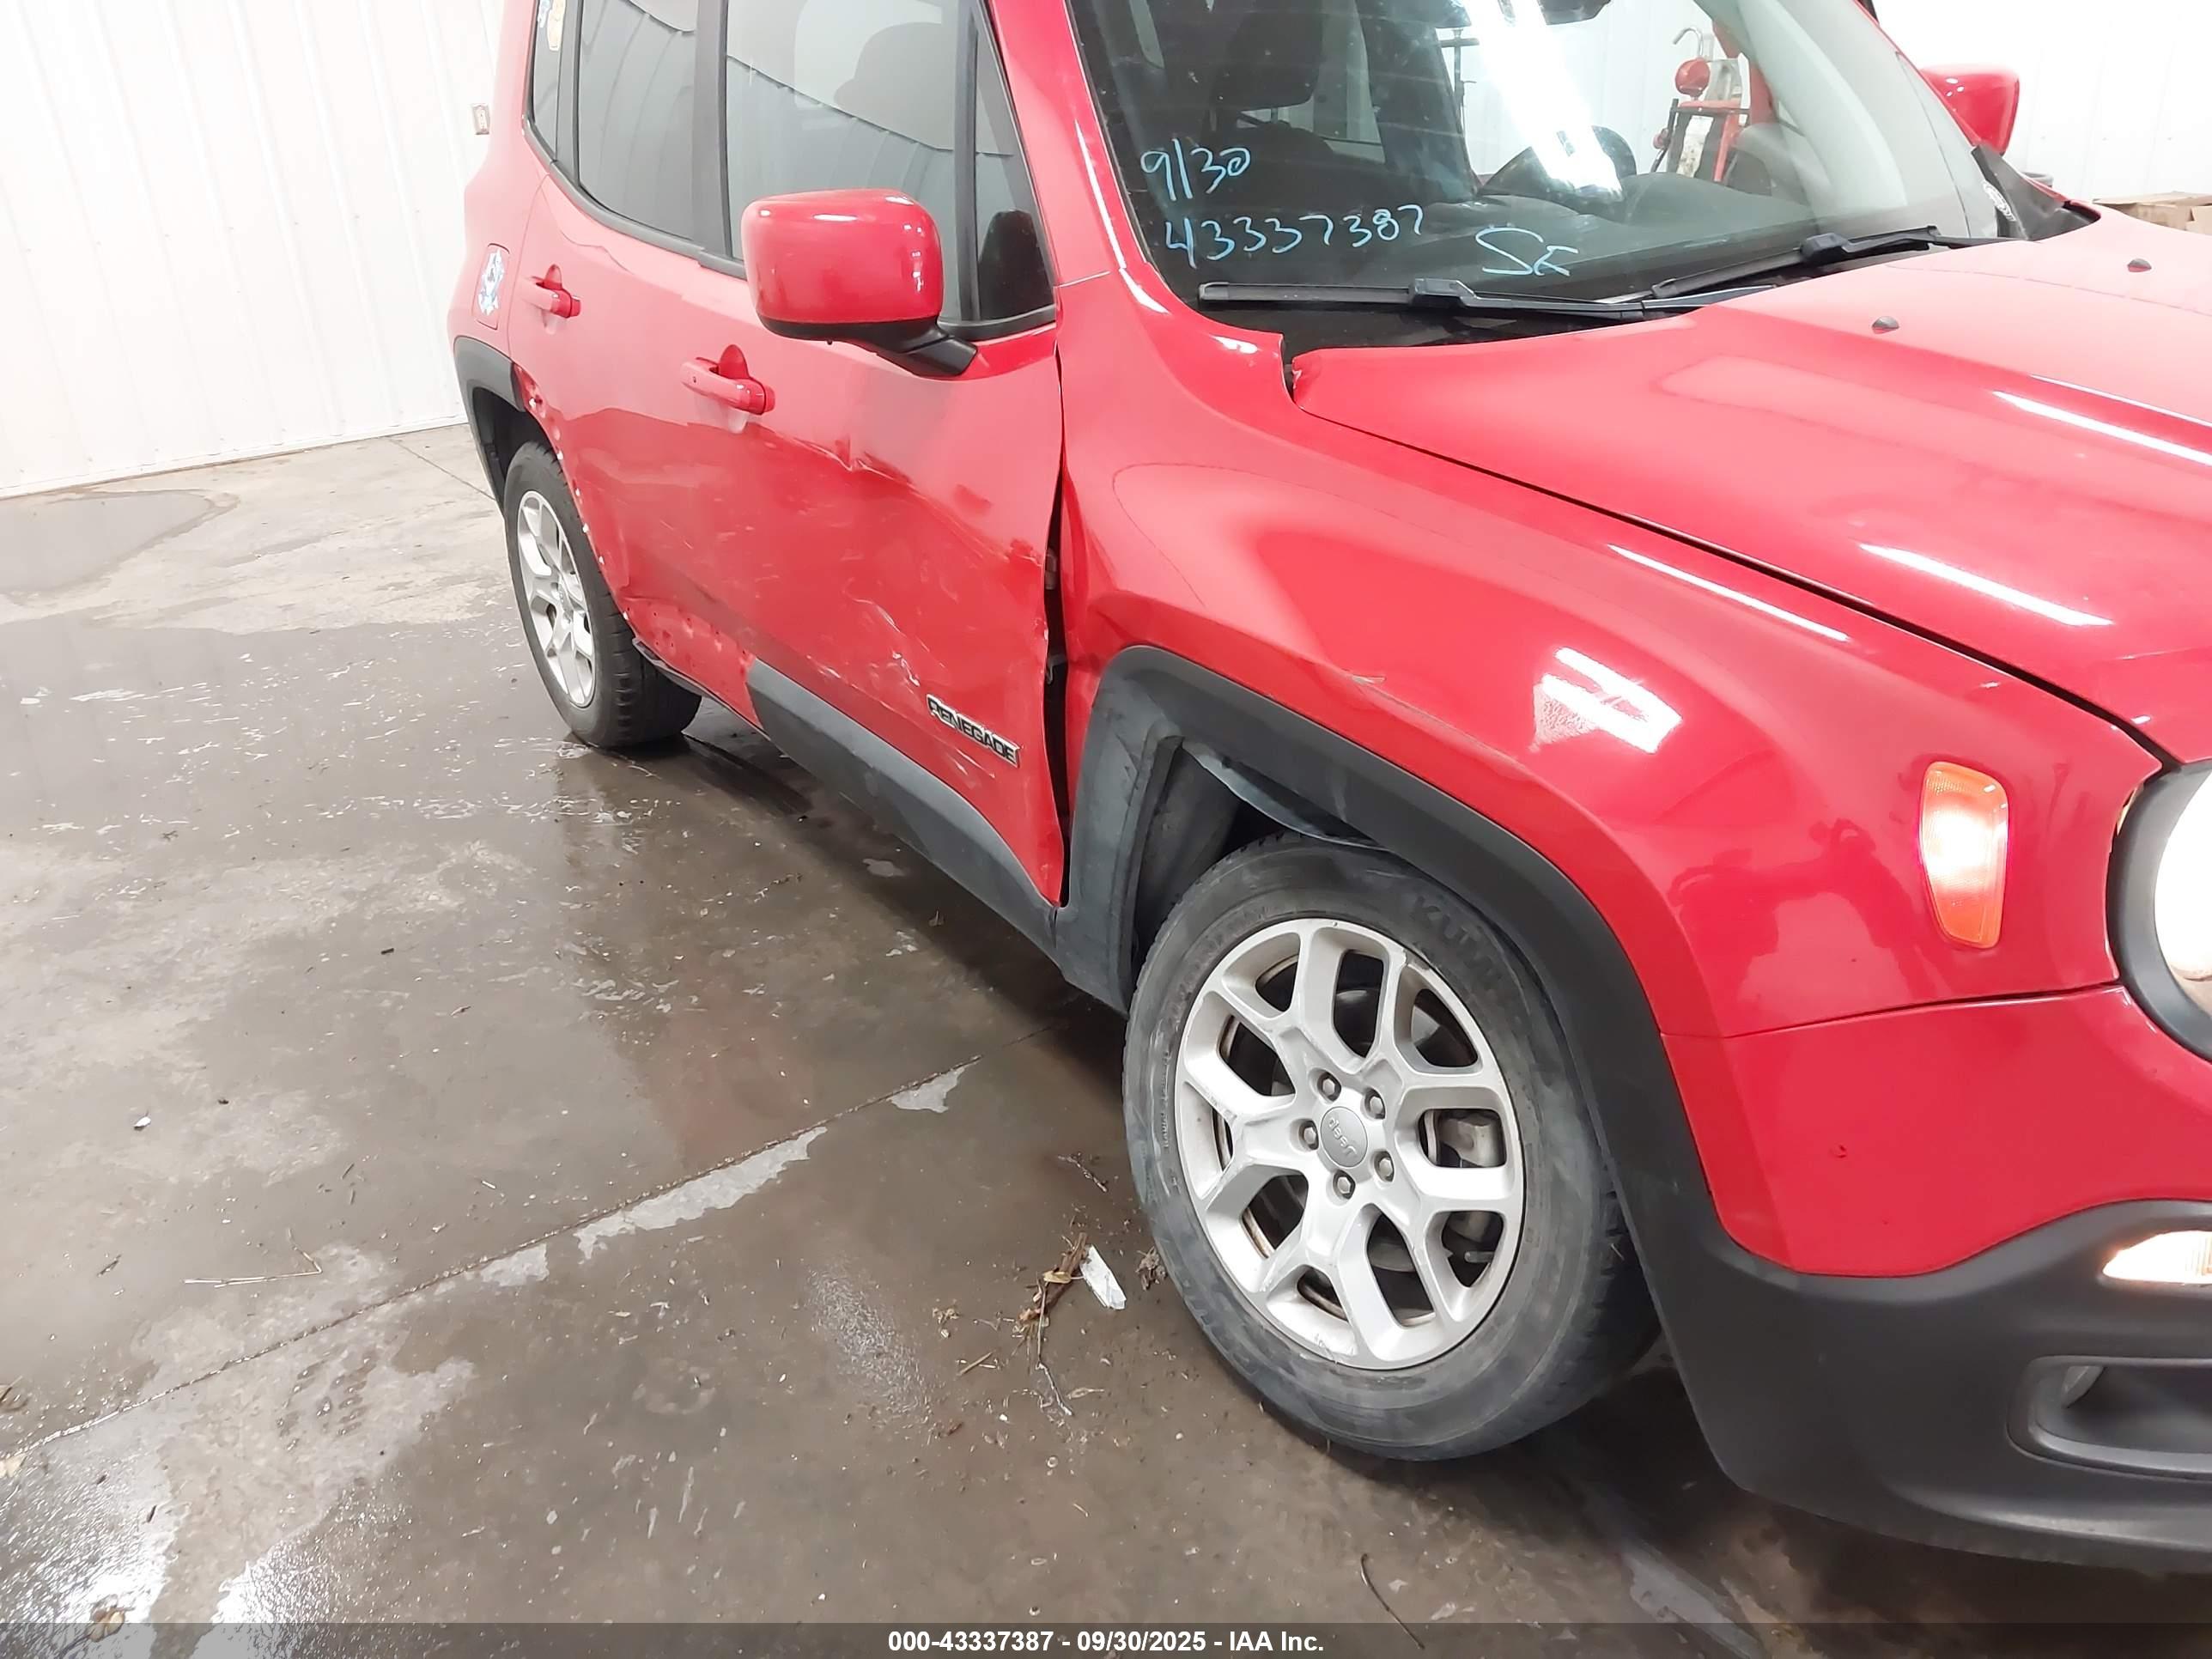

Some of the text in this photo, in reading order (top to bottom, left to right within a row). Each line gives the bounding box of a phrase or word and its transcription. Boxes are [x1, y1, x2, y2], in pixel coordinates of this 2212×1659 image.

[1164, 204, 1425, 270] 43337387
[927, 694, 1020, 767] RENEGADE
[1328, 1117, 1358, 1156] Jeep
